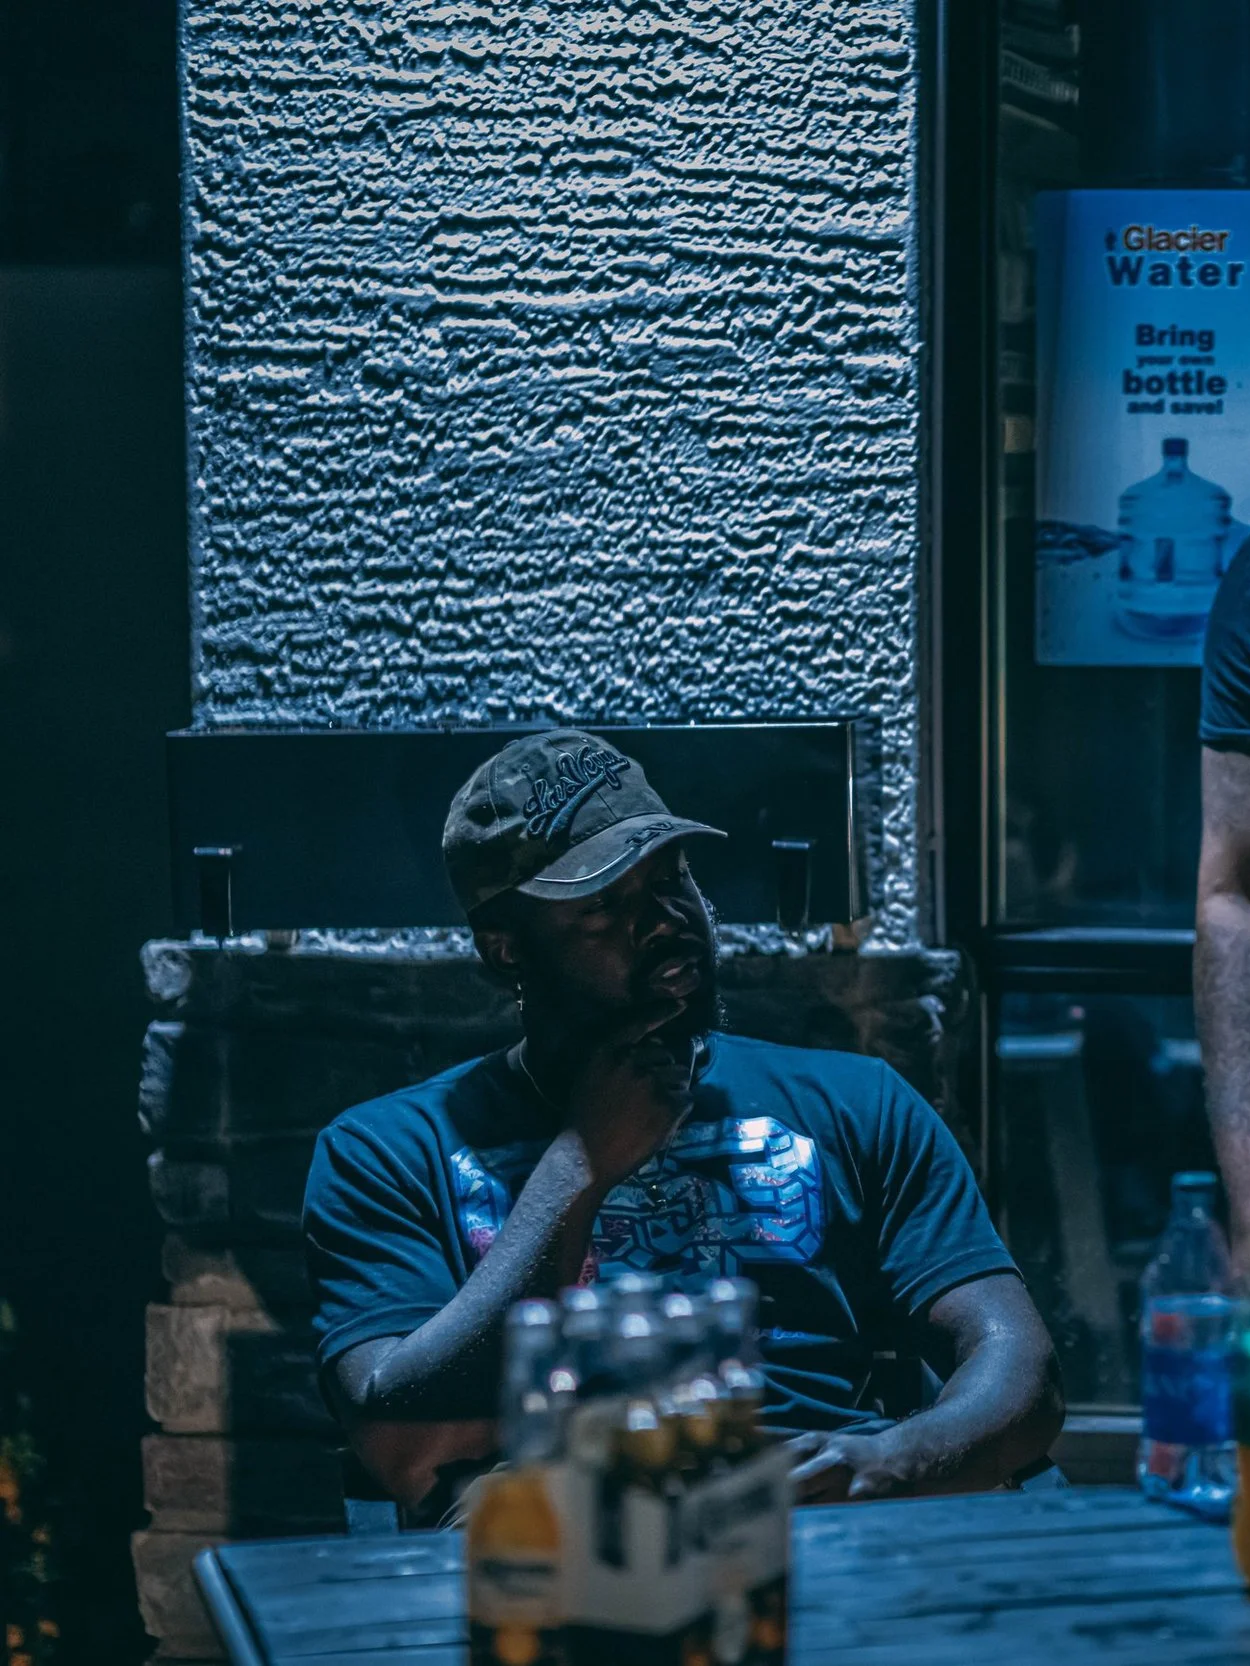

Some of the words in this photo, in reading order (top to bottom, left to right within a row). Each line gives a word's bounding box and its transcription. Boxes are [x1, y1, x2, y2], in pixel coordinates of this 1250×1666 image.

[1123, 224, 1229, 252] Glacier
[1106, 255, 1245, 288] Water
[1136, 324, 1215, 352] Bring
[1122, 369, 1228, 396] bottle
